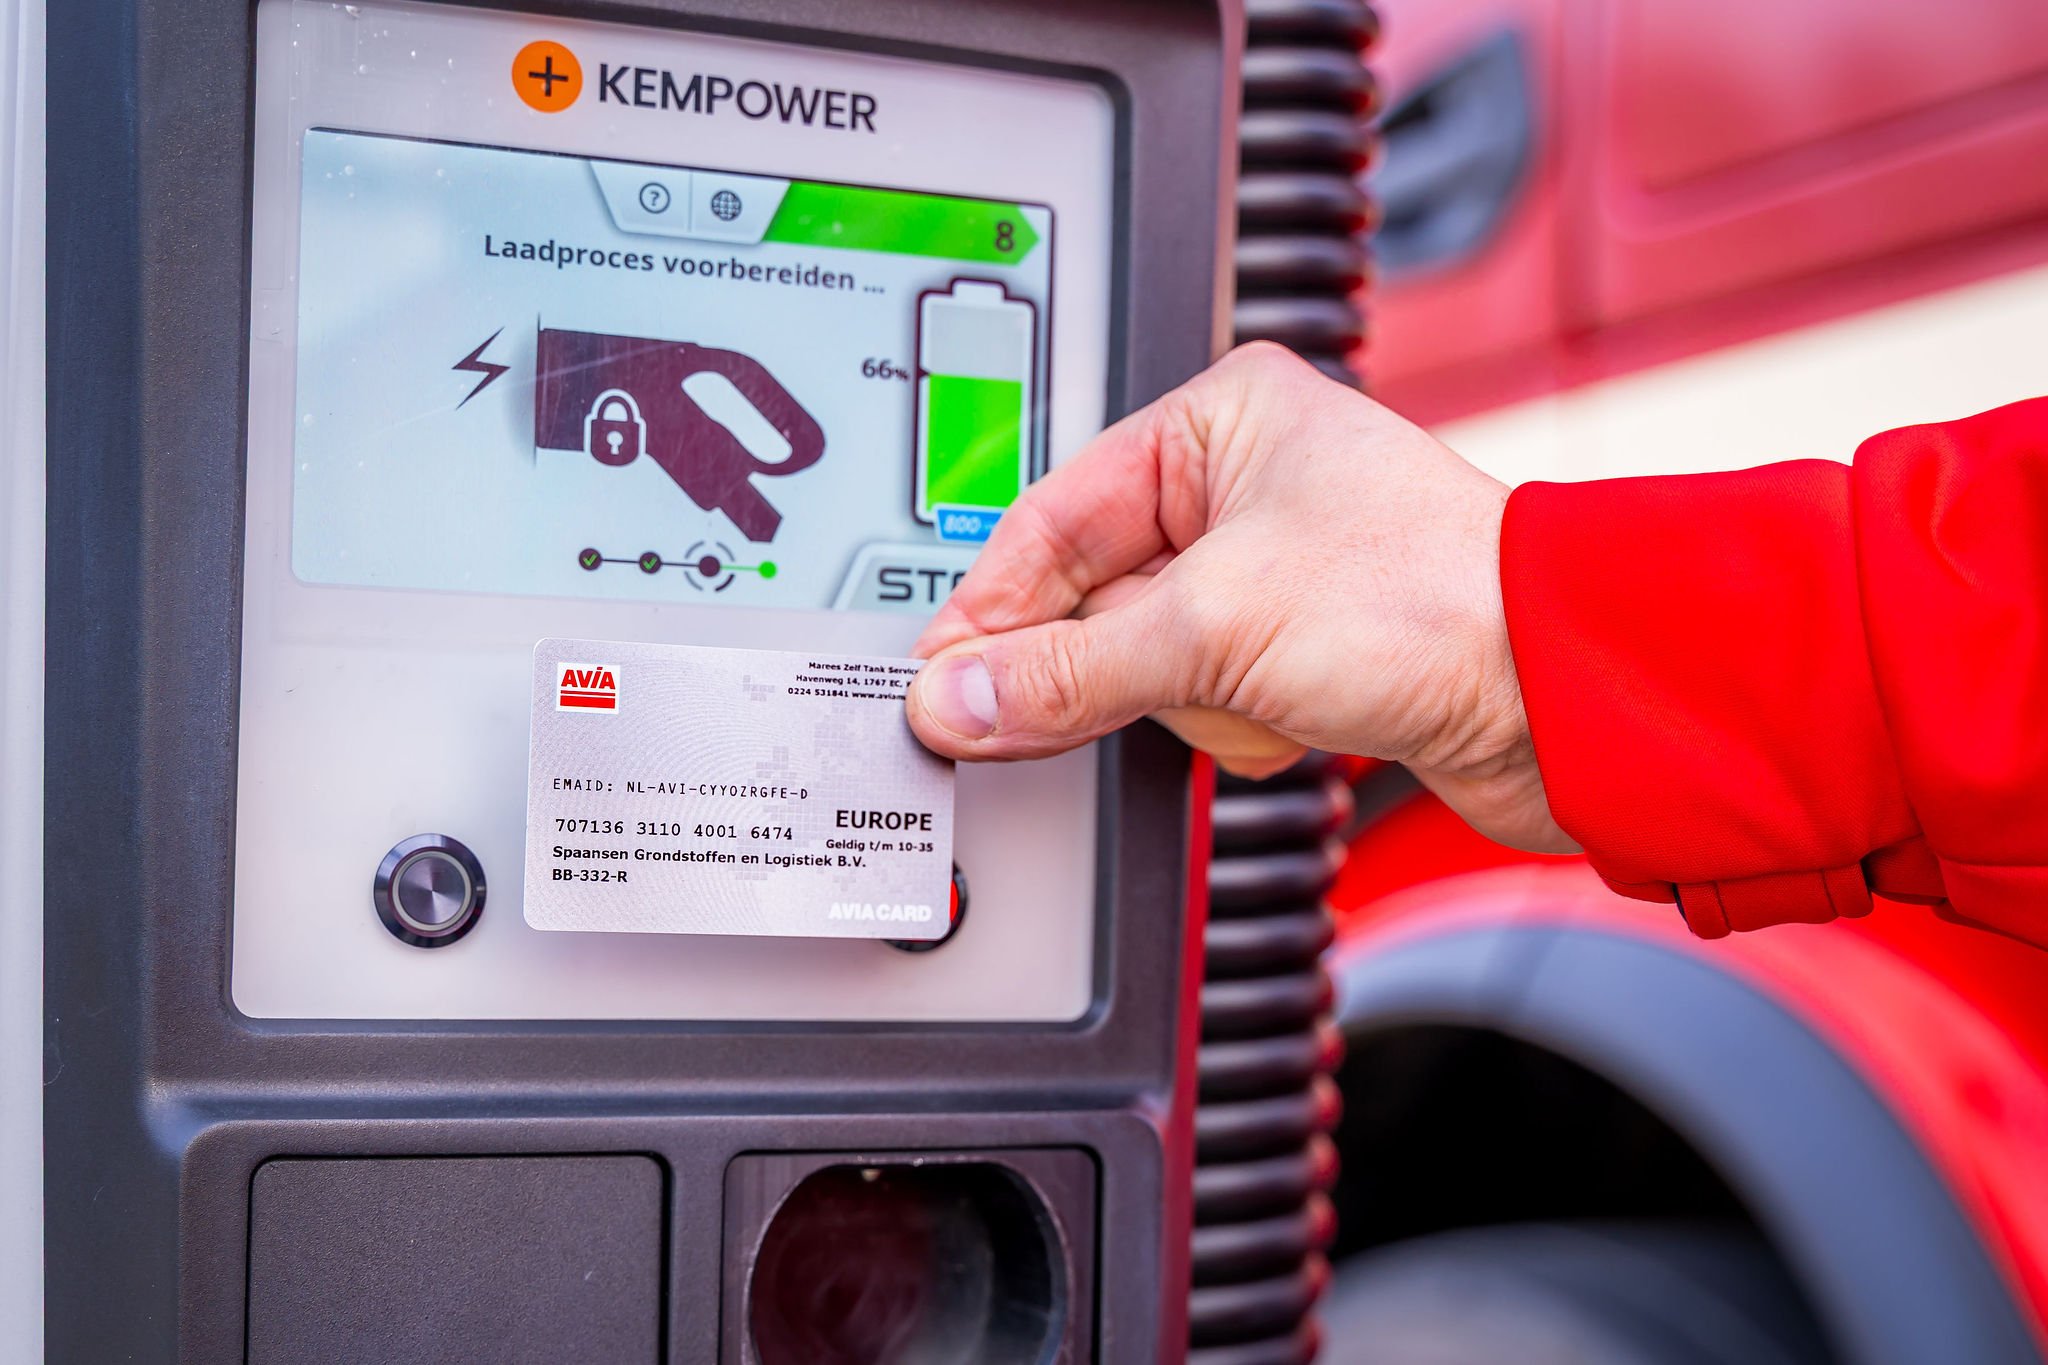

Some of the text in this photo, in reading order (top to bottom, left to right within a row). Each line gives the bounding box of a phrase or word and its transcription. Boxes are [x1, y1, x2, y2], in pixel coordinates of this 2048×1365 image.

[598, 62, 878, 134] KEMPOWER
[995, 221, 1015, 253] 8
[484, 234, 654, 272] Laadproces
[663, 254, 855, 291] voorbereiden
[944, 514, 981, 534] 800
[808, 661, 841, 671] Marees
[843, 663, 861, 672] Zelf
[863, 665, 885, 674] Tank
[796, 674, 843, 686] Havenweg
[846, 677, 861, 686] 14,
[864, 678, 887, 687] 1767
[787, 687, 906, 701] 0224 531841 www.aviam
[553, 778, 614, 793] EMAID:
[555, 819, 794, 841] 707136 3110 4001 6474
[835, 809, 934, 832] EUROPE
[825, 839, 935, 853] Geldig t/m 10-35
[552, 846, 867, 868] Spaansen Grondstoffen en Logistiek B.V.
[552, 868, 629, 884] BB-332-R
